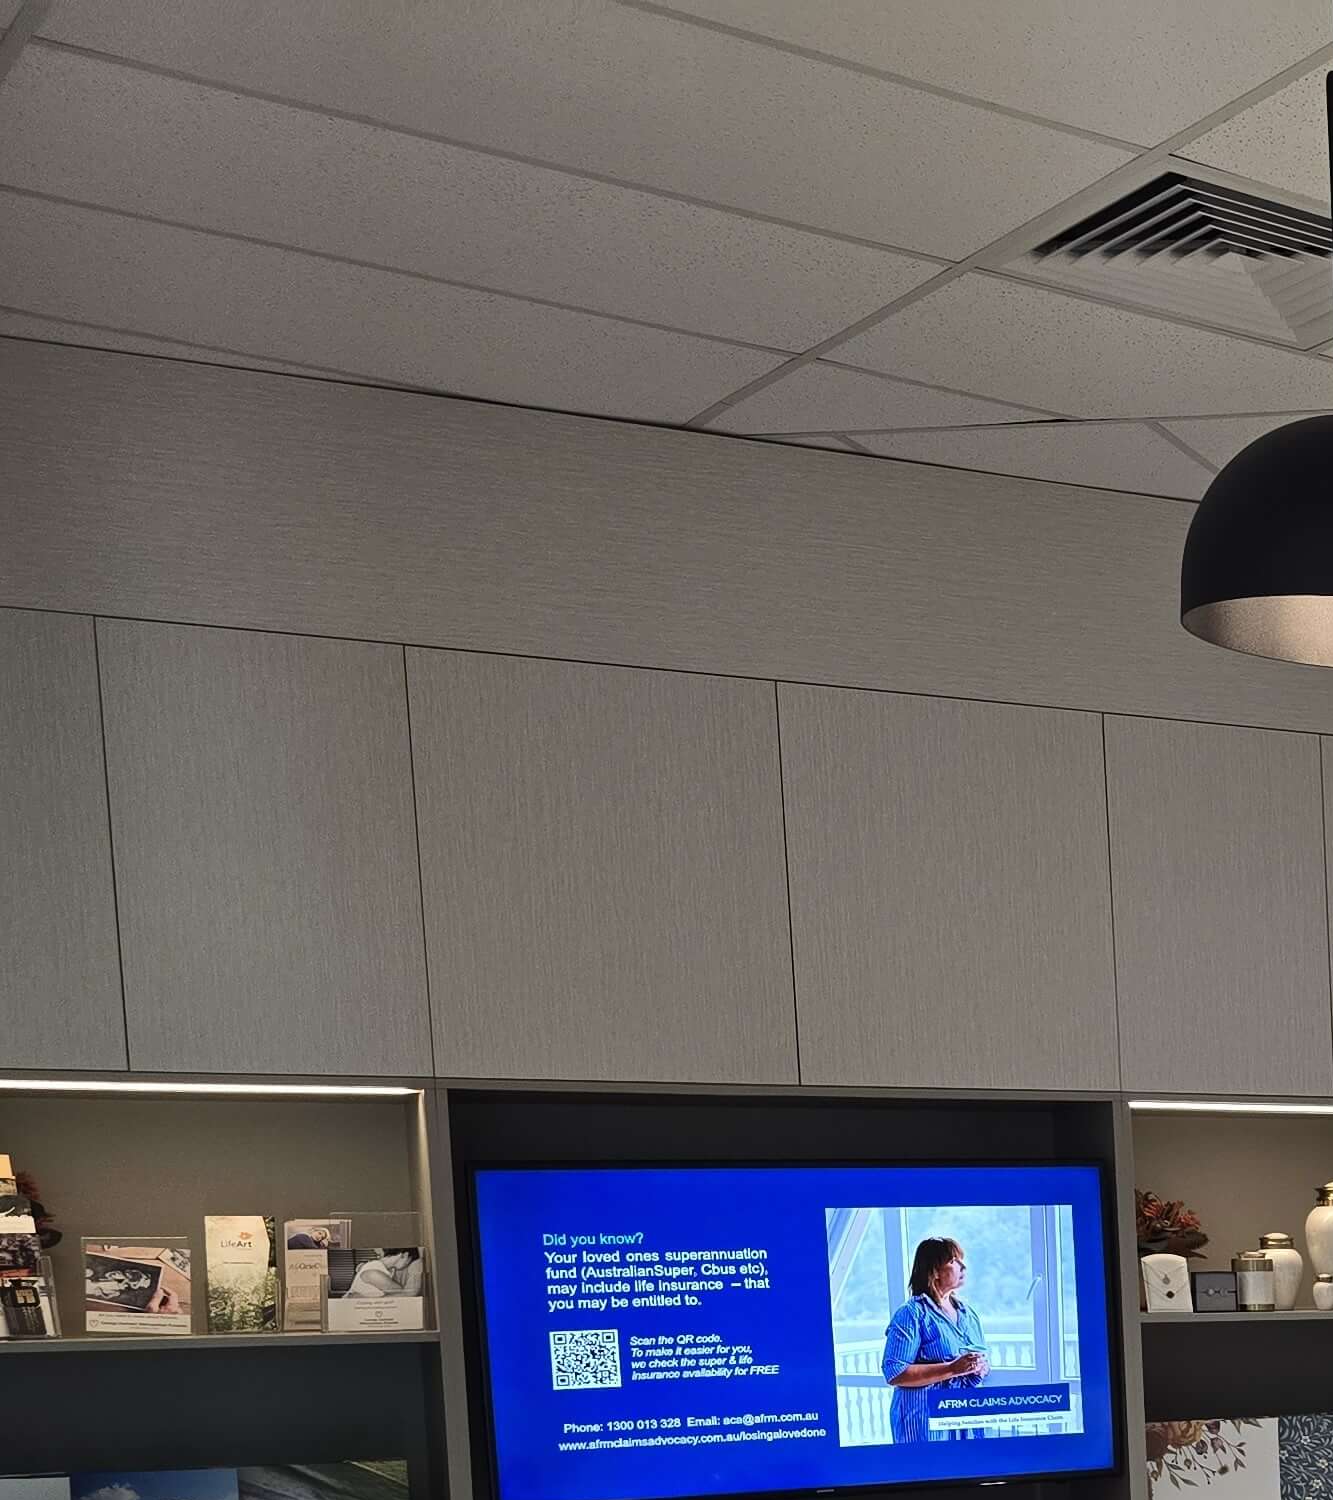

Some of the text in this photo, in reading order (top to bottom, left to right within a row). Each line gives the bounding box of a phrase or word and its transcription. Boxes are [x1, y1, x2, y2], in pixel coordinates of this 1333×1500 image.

[543, 1232, 644, 1249] Did you know?
[544, 1247, 768, 1264] Your loved ones superannuation
[545, 1266, 577, 1279] fund
[581, 1264, 698, 1281] (AustralianSuper,
[700, 1263, 737, 1276] Cbus
[547, 1284, 577, 1297] may
[581, 1281, 631, 1294] include
[634, 1280, 655, 1293] life
[658, 1279, 724, 1292] insurance
[744, 1277, 771, 1289] that
[548, 1294, 703, 1313] you may be entitled to.
[630, 1333, 723, 1346] Scan the QR code.
[631, 1347, 643, 1358] To
[645, 1346, 674, 1357] make
[675, 1346, 683, 1356] it
[684, 1345, 715, 1355] easier
[716, 1344, 731, 1355] for
[631, 1354, 754, 1369] we check the super & life
[631, 1364, 780, 1381] insurance availability for FREE
[938, 1394, 1063, 1409] AFRM CLAIMS ADVOCACY
[563, 1423, 604, 1434] Phone:
[606, 1420, 635, 1431] 1300
[636, 1418, 658, 1430] 013
[660, 1417, 681, 1428] 328
[687, 1416, 721, 1427] Email:
